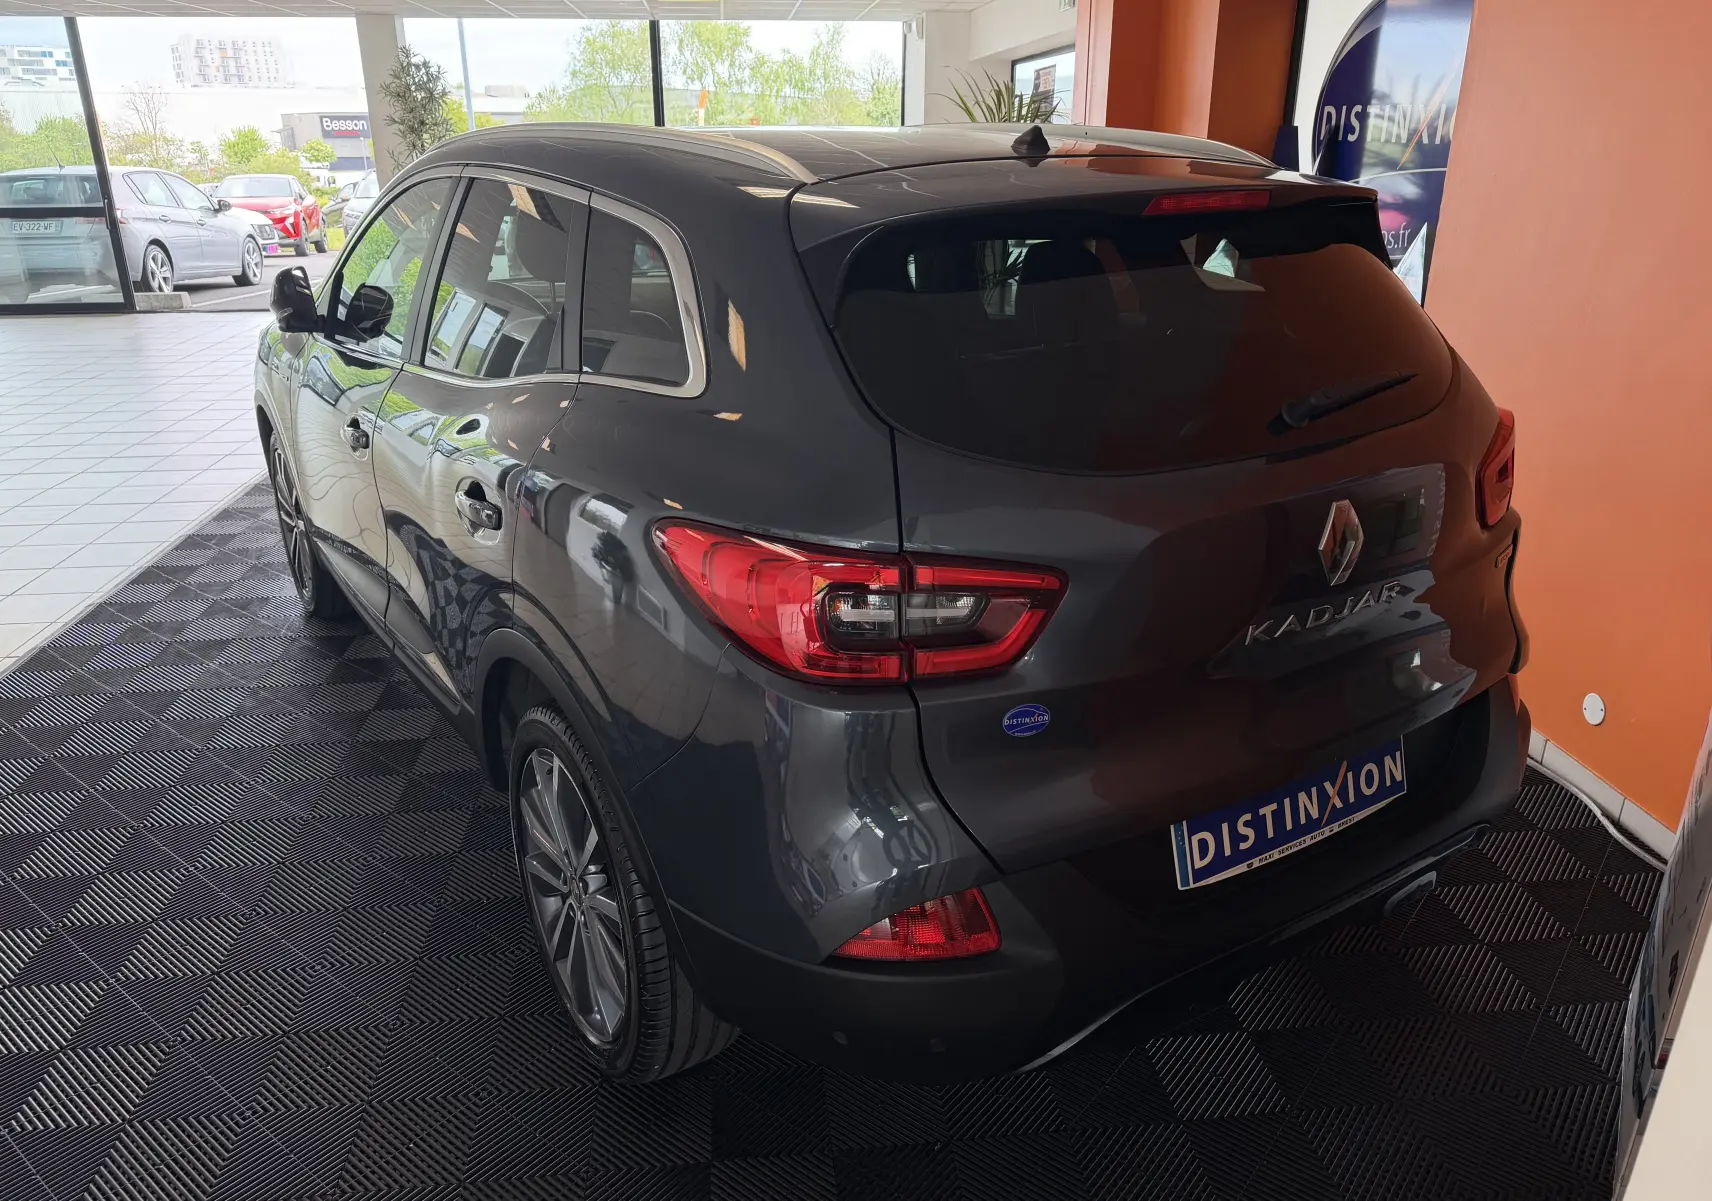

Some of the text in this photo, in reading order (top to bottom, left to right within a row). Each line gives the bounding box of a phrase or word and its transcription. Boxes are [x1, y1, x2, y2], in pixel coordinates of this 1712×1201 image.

[322, 117, 368, 131] Besson
[1319, 102, 1457, 148] DISTINXI
[1244, 580, 1401, 646] KADJAR
[1004, 713, 1049, 726] DISTINXION
[1190, 750, 1403, 870] DISTINXION
[1258, 852, 1275, 864] MAXI
[1277, 839, 1307, 856] SERVICES
[1309, 830, 1326, 842] AUTO
